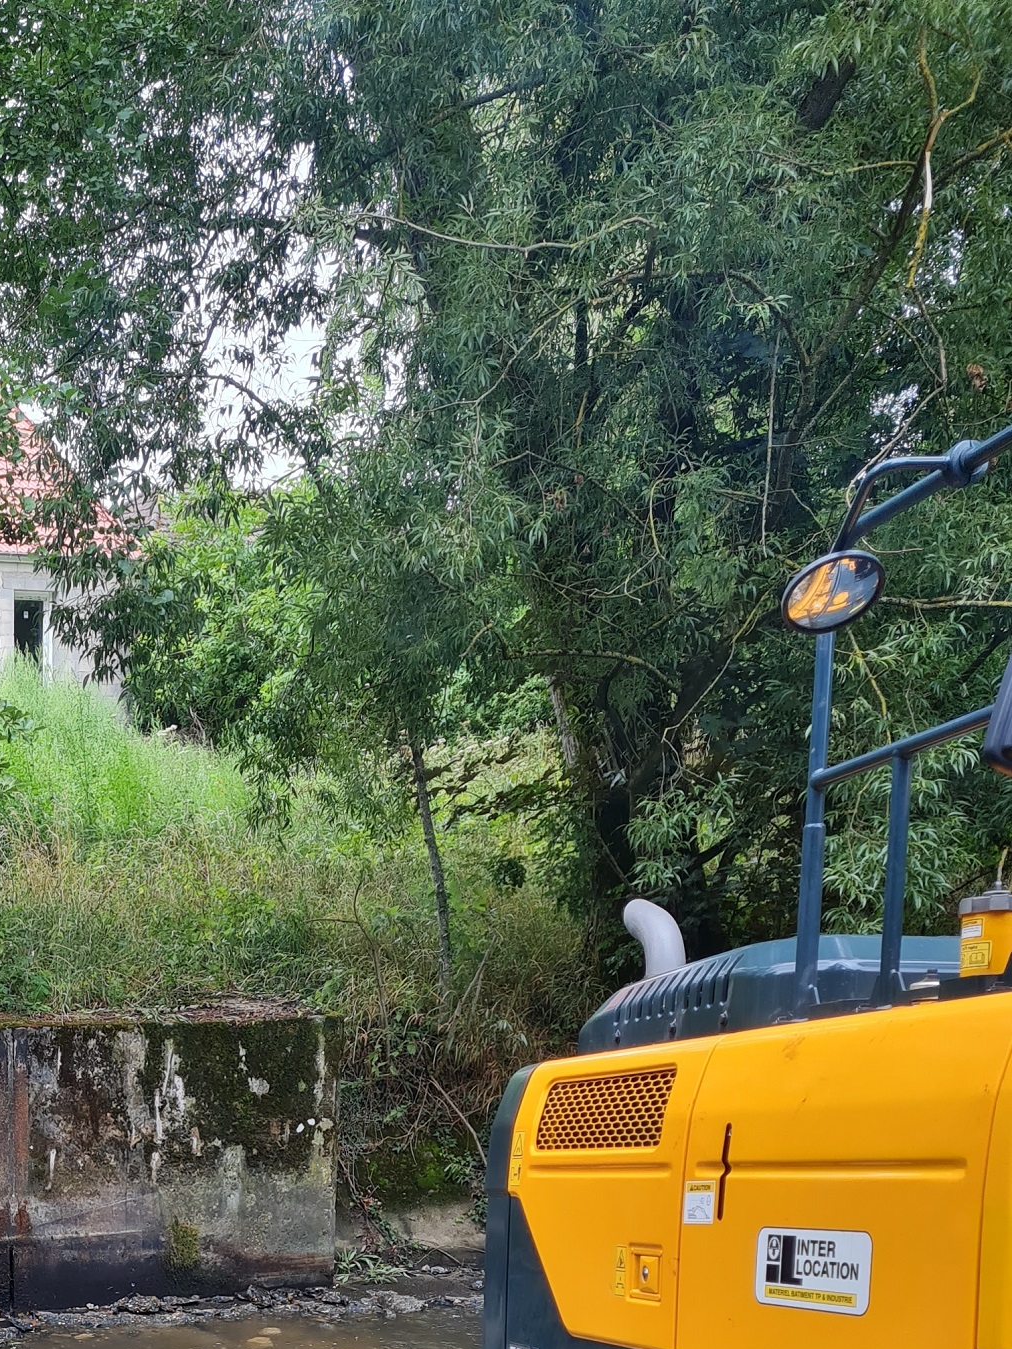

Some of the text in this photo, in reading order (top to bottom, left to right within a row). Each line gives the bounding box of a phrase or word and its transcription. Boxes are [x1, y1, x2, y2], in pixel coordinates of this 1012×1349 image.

[797, 1239, 836, 1258] INTER
[796, 1259, 859, 1280] LOCATION
[768, 1288, 790, 1297] MATERIEL
[791, 1290, 814, 1299] BATIMENT
[827, 1295, 853, 1304] INDUSTRIE
